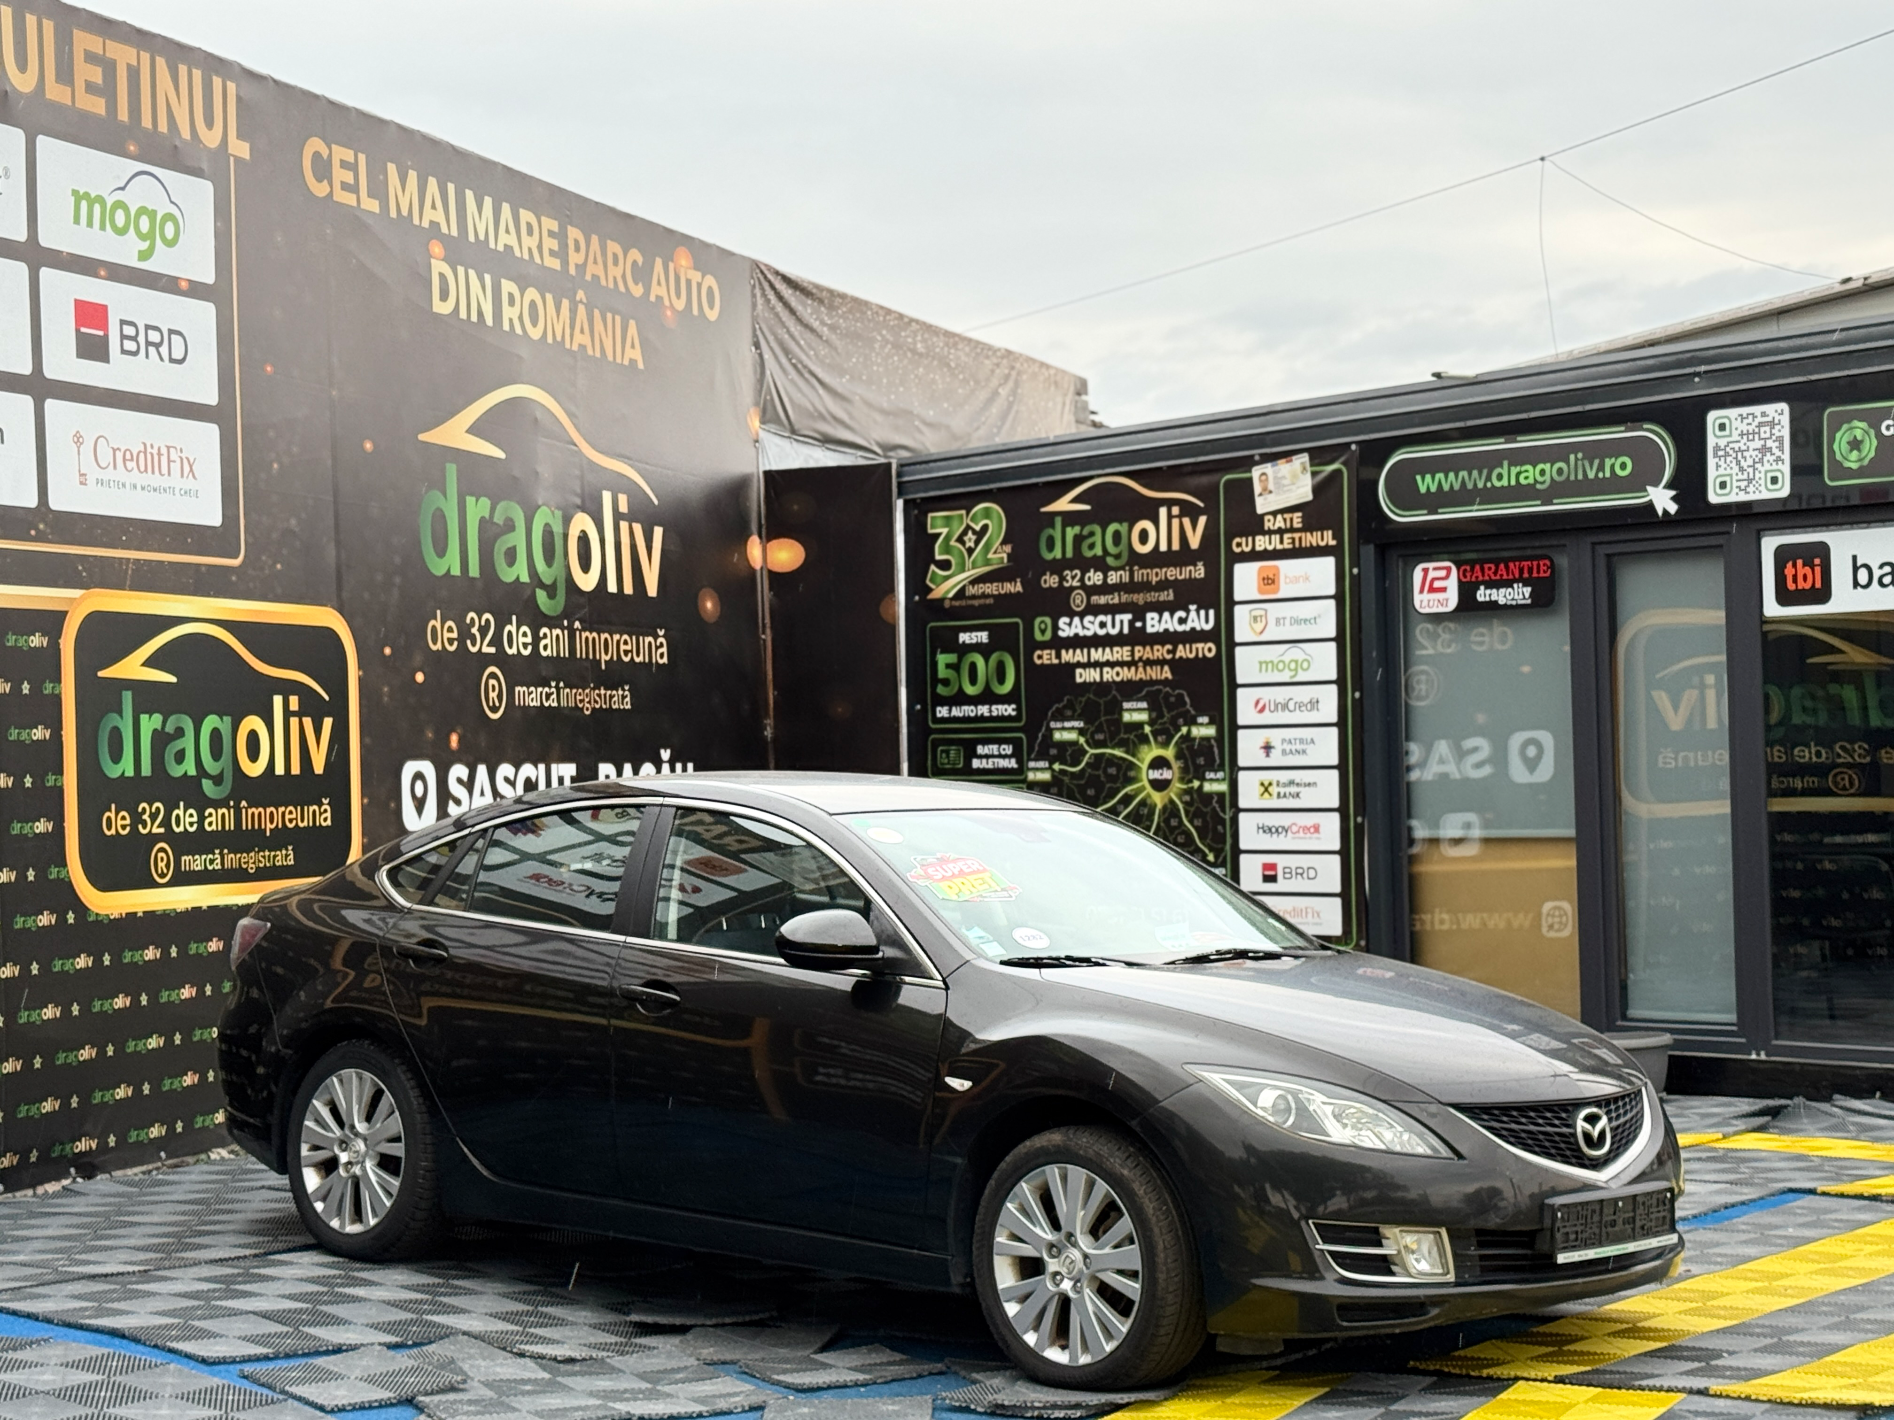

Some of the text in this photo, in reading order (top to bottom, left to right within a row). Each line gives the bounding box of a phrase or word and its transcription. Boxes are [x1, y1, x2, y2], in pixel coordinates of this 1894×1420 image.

[0, 3, 250, 160] ULETINUL
[71, 188, 181, 262] mogo
[302, 137, 721, 322] CEL MAI MARE PARC AUTO
[430, 258, 644, 370] DIN ROMÂNIA
[119, 318, 189, 365] BRD
[93, 434, 198, 481] CreditFix
[1416, 453, 1633, 494] www.dragoliv.ro
[96, 477, 199, 499] PRIETEN IN MOMENTE CHEIE
[1263, 512, 1303, 530] RATE
[419, 462, 664, 617] dragoliv
[925, 502, 1007, 589] 32
[1039, 505, 1207, 567] dragoliv
[1232, 531, 1337, 552] CU BULETINUL
[1041, 562, 1205, 588] de 32 de ani împreună
[1262, 573, 1310, 586] tbi bank
[1418, 566, 1452, 594] 12
[1458, 558, 1551, 582] GARANTIE
[1784, 554, 1894, 590] tbi ba
[1090, 592, 1119, 605] marcă
[1120, 589, 1174, 605] înregistrată
[1419, 598, 1449, 610] LUNI
[1476, 583, 1532, 605] dragoliv
[1058, 613, 1132, 638] SASCUT
[1146, 605, 1215, 634] BACĂU
[1275, 619, 1287, 628] BT
[5, 631, 48, 650] dragoliv
[427, 610, 668, 670] de 32 de ani împreună
[959, 630, 988, 644] PESTE
[1034, 643, 1216, 665] CEL MAI MARE PARC AUTO
[936, 651, 1015, 696] 500
[1075, 663, 1173, 683] DIN ROMÂNIA
[1258, 657, 1311, 680] mogo
[514, 681, 557, 707] marcă
[559, 682, 631, 715] înregistrată
[1268, 697, 1320, 714] UniCredit
[936, 704, 1016, 718] DE AUTO PE STOC
[7, 725, 51, 744] dragoliv
[98, 690, 333, 799] dragoliv
[1281, 737, 1316, 747] PATRIA
[976, 744, 1013, 756] RATE CU
[1281, 748, 1308, 757] BANK
[972, 757, 1018, 769] BULETINUL
[1148, 767, 1173, 780] BACĂU
[1276, 779, 1317, 789] Raiffeisen
[1276, 791, 1301, 800] BANK
[10, 818, 54, 838] dragoliv
[102, 798, 331, 836] de 32 de ani împreună
[1256, 822, 1321, 838] HappyCredit
[181, 850, 222, 872] marcă
[223, 846, 295, 873] înregistrată
[926, 859, 984, 881] SUPER
[47, 864, 69, 881] drag
[1282, 866, 1318, 881] BRD
[13, 910, 57, 931] dragoliv
[1271, 905, 1321, 920] reditFix
[0, 936, 224, 979] oliv dragoliv dragoliv dragoliv
[17, 1003, 62, 1025] dragoliv
[90, 993, 131, 1013] dragoliv
[158, 983, 197, 1004] dragoliv
[0, 1026, 218, 1075] oliv dragoliv dragoliv drago
[16, 1070, 199, 1119] dragoliv dragoliv dragoliv
[0, 1109, 225, 1169] oliv dragoliv dragoliv dragoli
